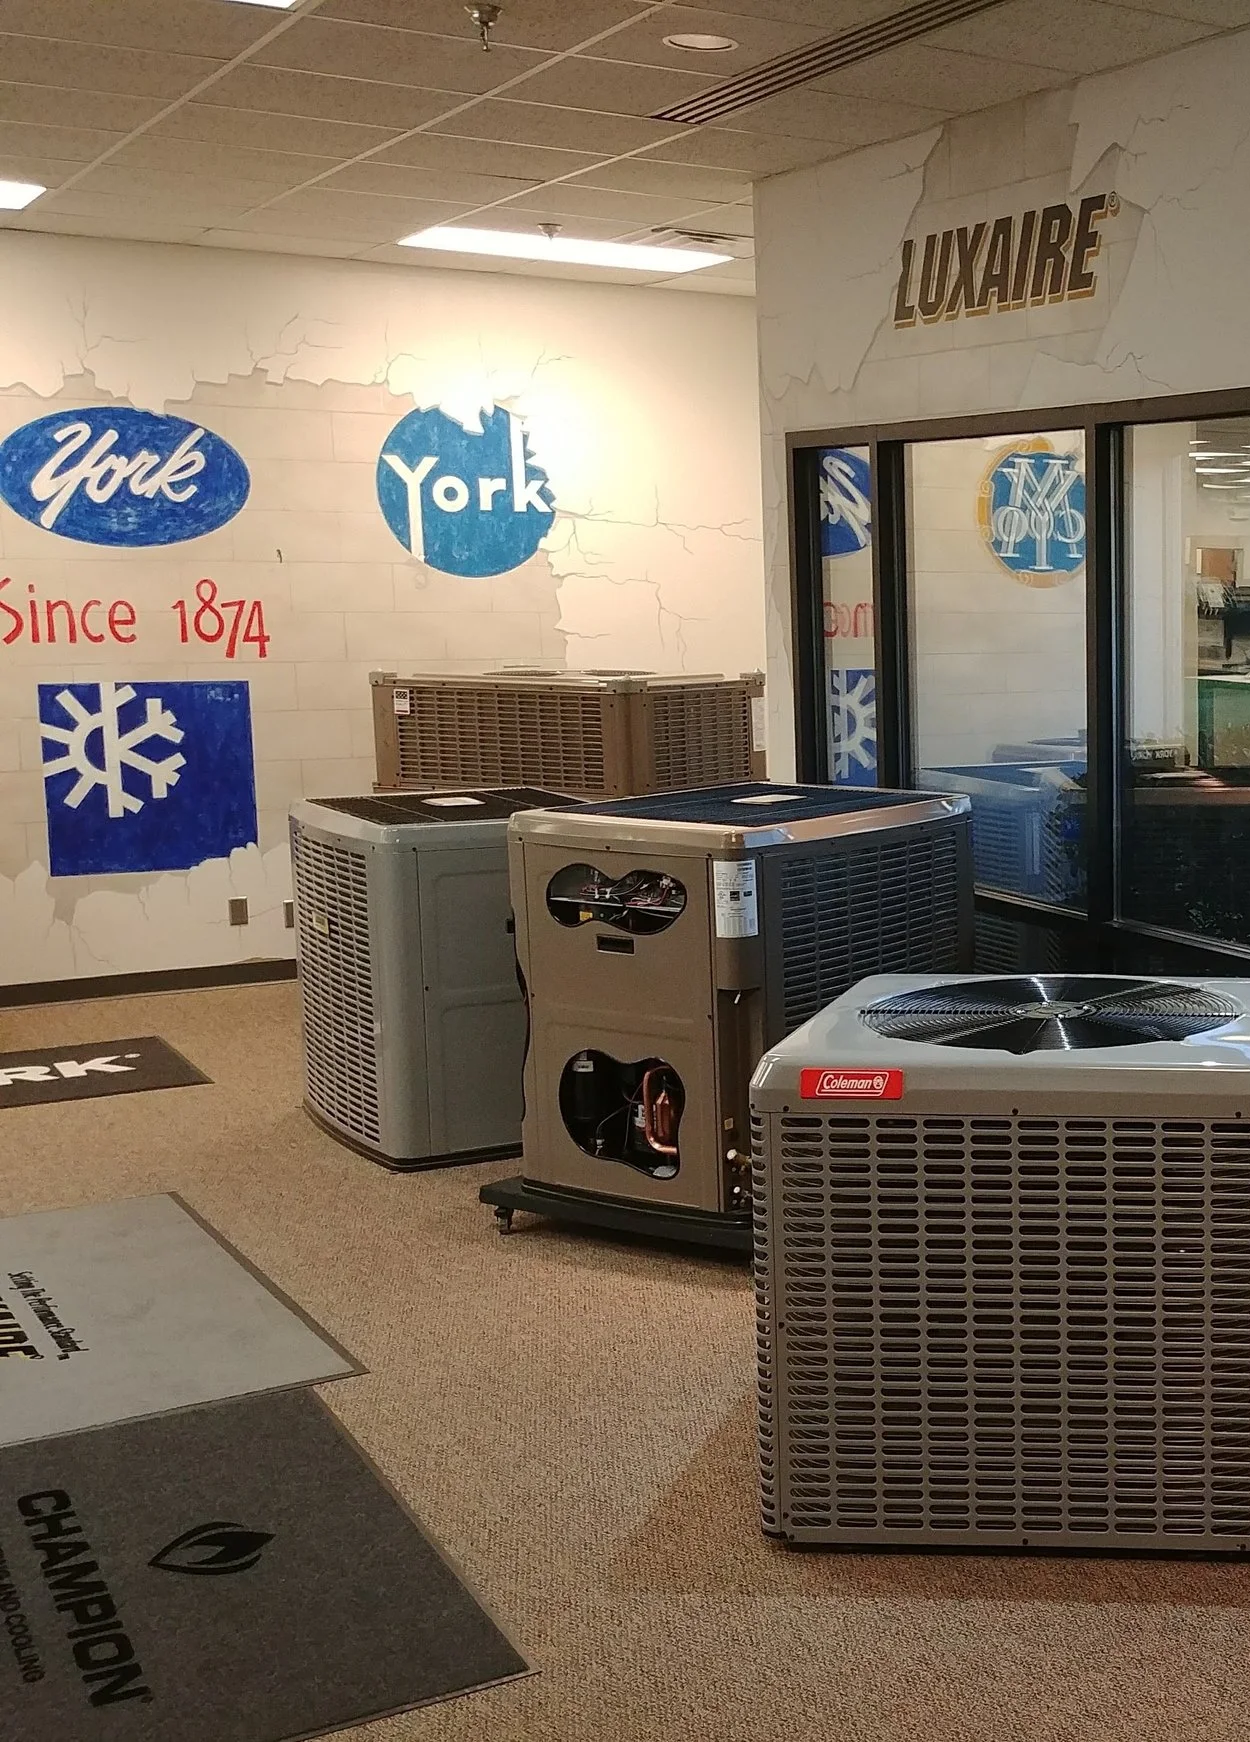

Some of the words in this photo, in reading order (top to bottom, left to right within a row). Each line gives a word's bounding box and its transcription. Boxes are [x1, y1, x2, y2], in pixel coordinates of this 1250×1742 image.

[30, 420, 206, 530] York
[381, 411, 553, 562] York
[171, 578, 271, 659] 1874
[823, 1074, 872, 1090] Coleman
[4, 1613, 46, 1683] COOLING
